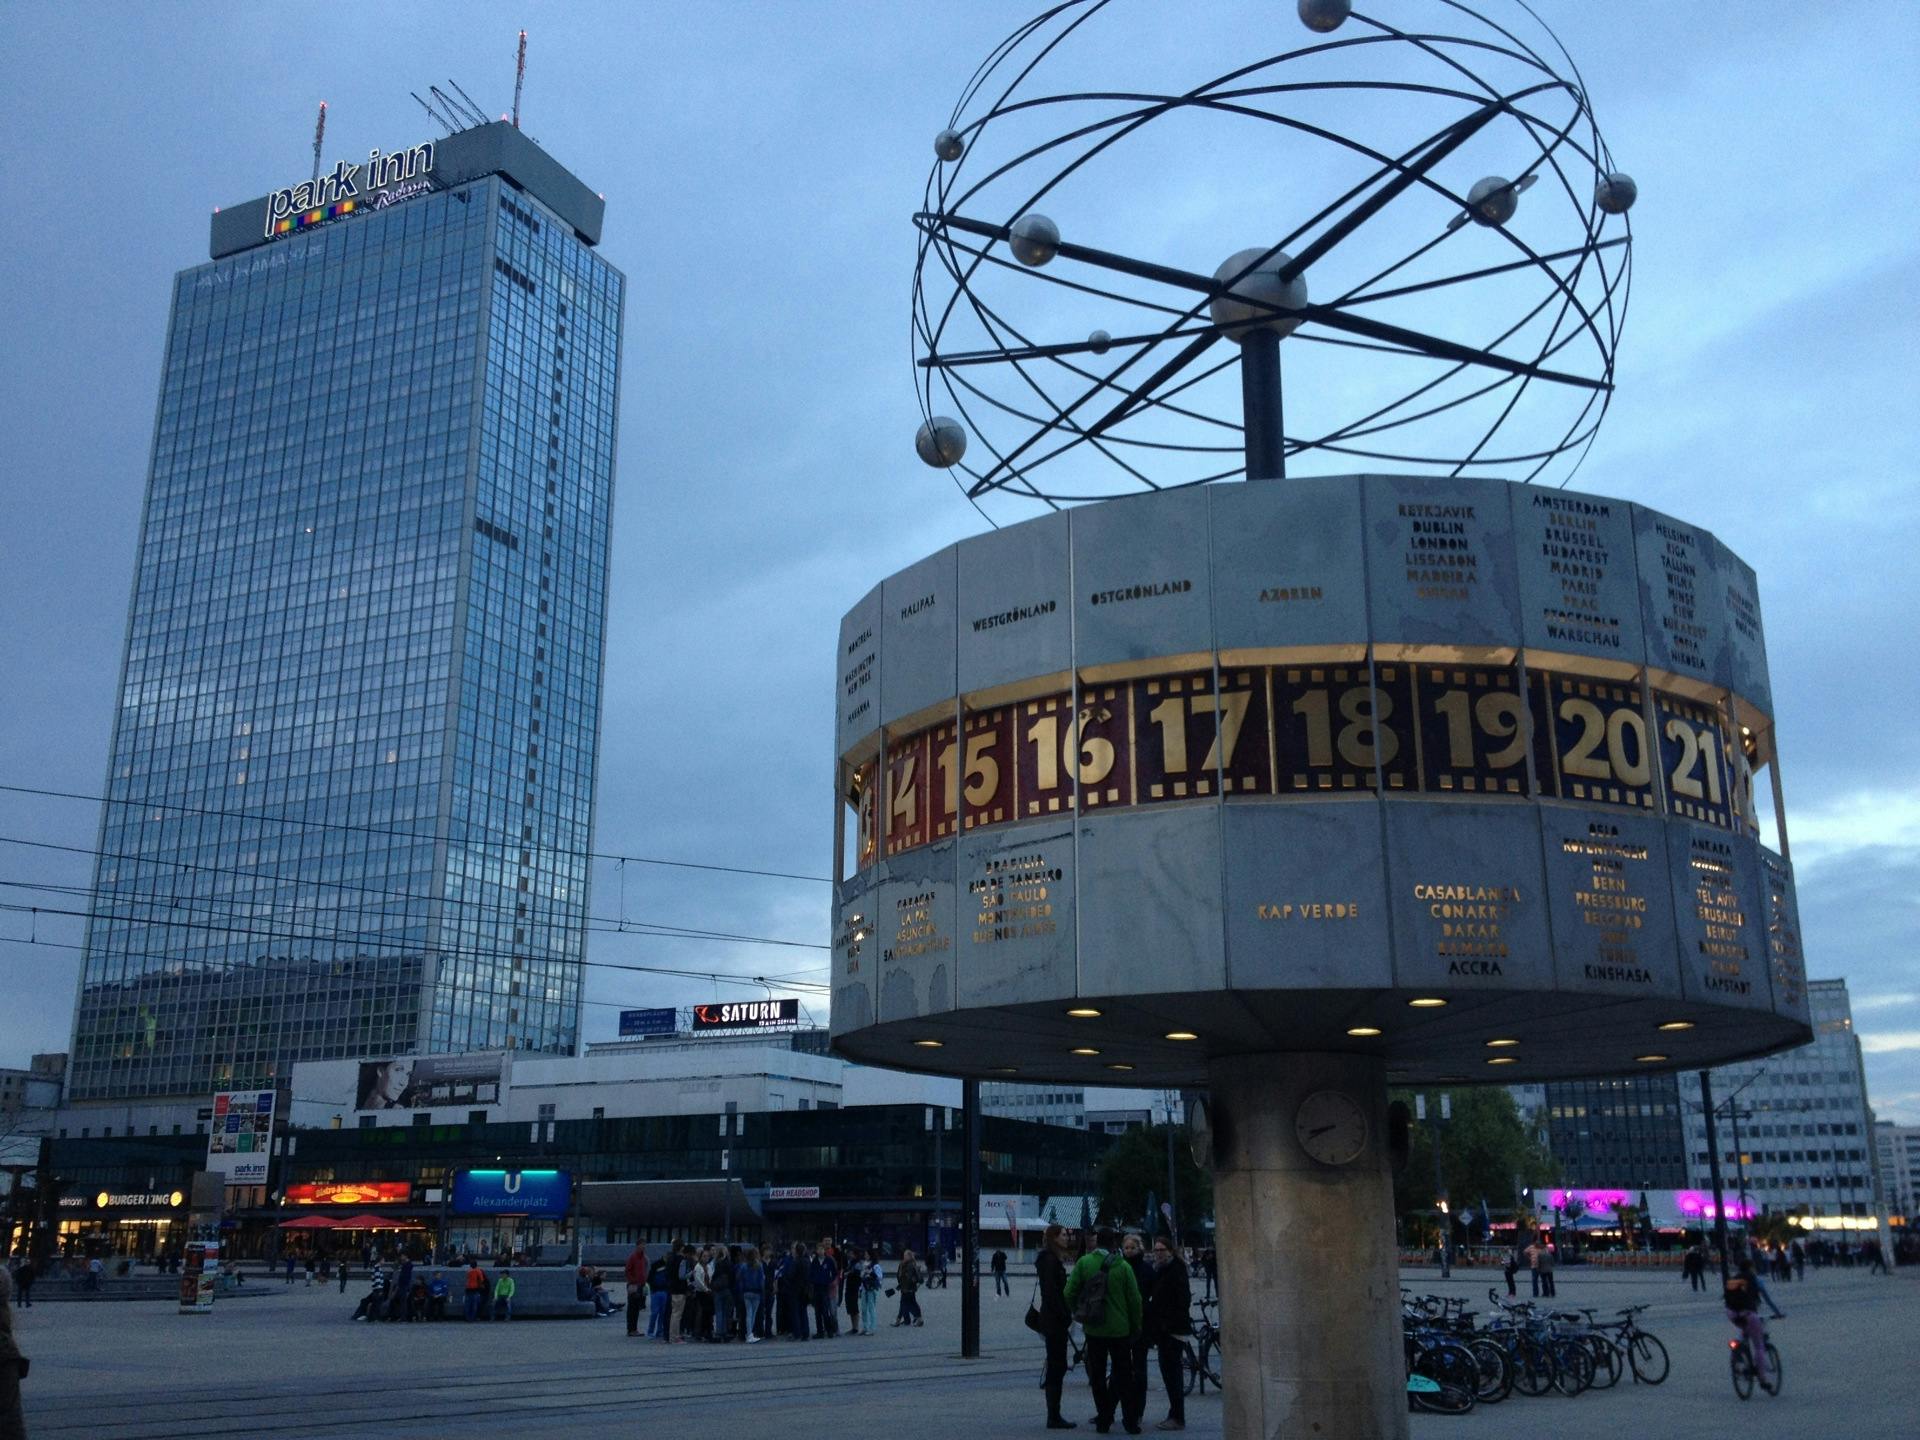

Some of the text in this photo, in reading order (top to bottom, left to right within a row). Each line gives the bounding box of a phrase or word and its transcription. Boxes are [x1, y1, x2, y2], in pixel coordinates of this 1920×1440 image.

[264, 141, 434, 237] park inn
[376, 181, 431, 211] Radisson
[1398, 503, 1476, 521] REYKJAVIK
[1533, 495, 1610, 517] AMSTERDAM
[1413, 521, 1465, 535] DUBLIN
[1550, 514, 1597, 530] BERLIN
[1410, 537, 1469, 550] LONDON
[1656, 523, 1695, 547] HELSINKI
[1405, 551, 1477, 568] LISSABON
[1542, 543, 1609, 566] BUDAPEST
[1666, 542, 1688, 559] RIGA
[1551, 562, 1604, 580] MADRID
[1661, 555, 1696, 578] TALLINN
[1259, 587, 1323, 603] AZOREN
[1561, 578, 1598, 595] PARIS
[901, 593, 936, 621] HALIFAX
[972, 600, 1057, 632] WESTGRÖNLAND
[1547, 625, 1620, 648] WARSCHAU
[1149, 691, 1254, 775] 17
[1292, 687, 1400, 768] 18
[1435, 690, 1534, 770] 19
[1028, 708, 1116, 791] 16
[1559, 698, 1652, 787] 20
[1665, 719, 1723, 804] 21
[937, 731, 1000, 816] 15
[884, 757, 918, 837] 14
[1563, 838, 1649, 860] KOPENHAGEN
[1692, 839, 1732, 856] ANKARA
[986, 854, 1045, 875] BRASILIA
[969, 868, 1063, 894] RIO DE JANEIRO
[1593, 876, 1626, 892] BERN
[1414, 885, 1521, 902] CASABLANCA
[1576, 892, 1647, 913] PRESSBURG
[1696, 888, 1738, 909] TEL AVIV
[901, 912, 912, 926] LA
[1258, 903, 1358, 920] KAP VERDE
[1443, 923, 1500, 937] DAKAR
[1706, 924, 1737, 941] BEIRUT
[1448, 961, 1502, 977] ACCRA
[1585, 964, 1652, 983] KINSHASA
[1704, 975, 1751, 995] KAPSTADT
[721, 1001, 781, 1022] SATURN
[235, 1164, 265, 1173] park inn
[504, 1174, 521, 1194] U
[771, 1188, 785, 1198] ASIA
[108, 1194, 145, 1206] BURGER
[473, 1196, 549, 1208] Alexanderplatz
